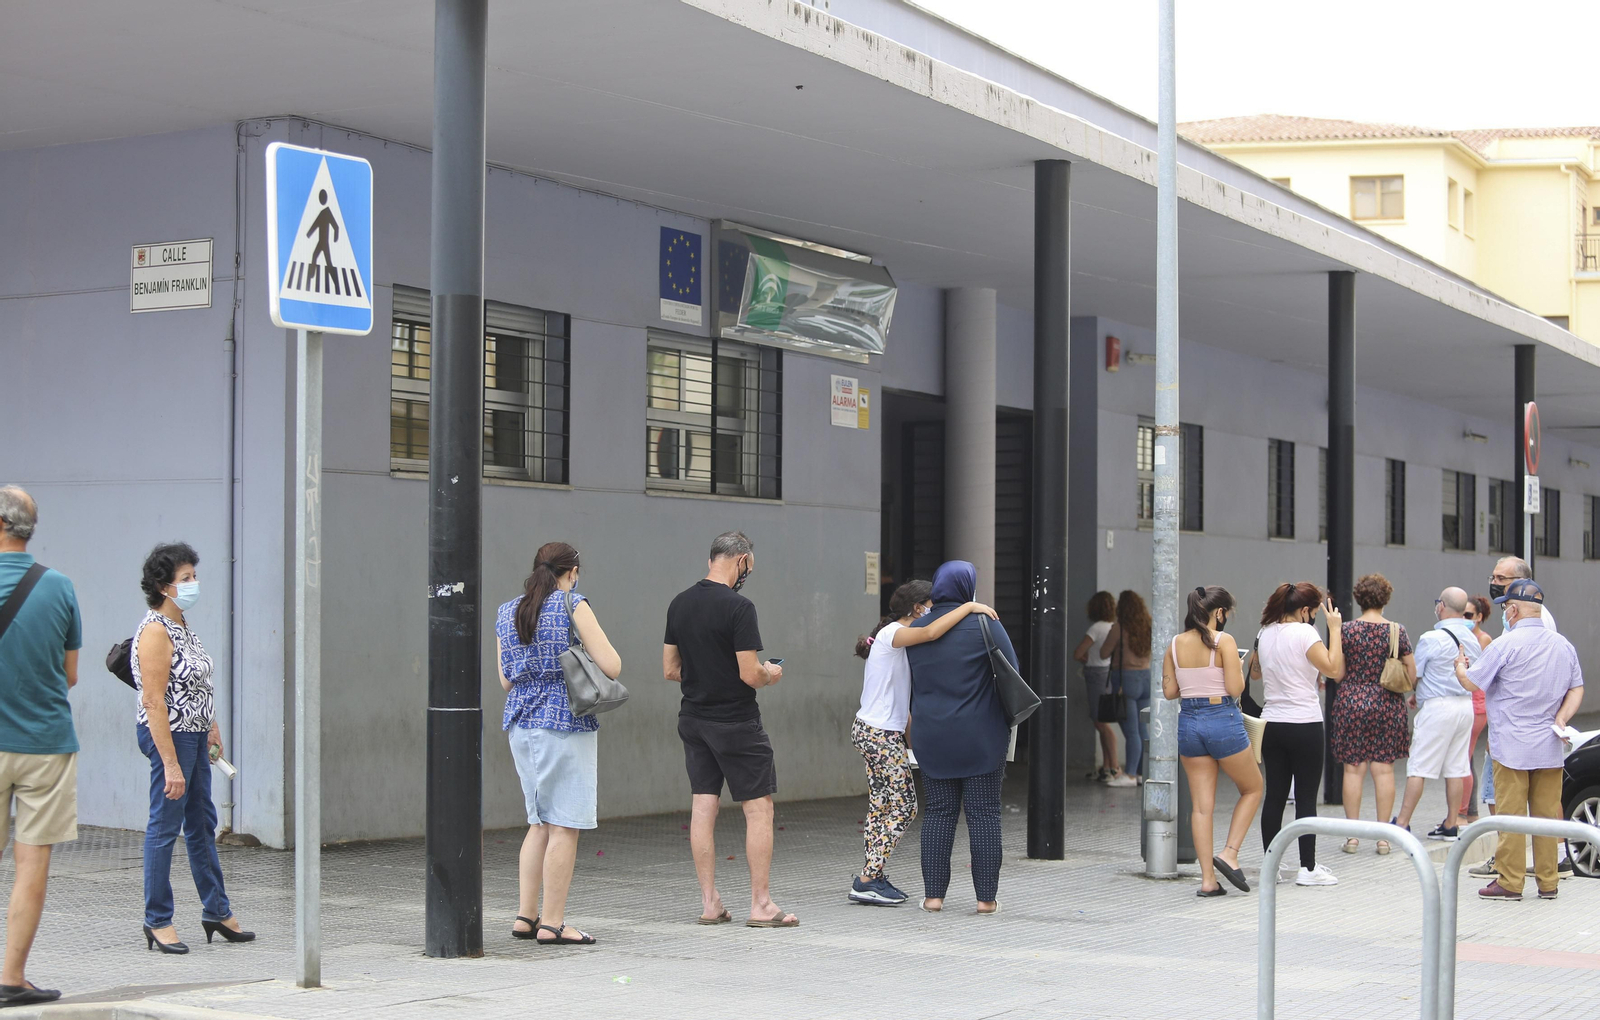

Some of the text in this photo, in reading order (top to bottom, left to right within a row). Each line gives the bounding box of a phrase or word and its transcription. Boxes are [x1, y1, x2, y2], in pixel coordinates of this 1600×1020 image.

[162, 247, 187, 262] CALLE
[134, 277, 207, 295] BENJAMÍN FRANKLIN
[832, 395, 856, 408] ALARMA
